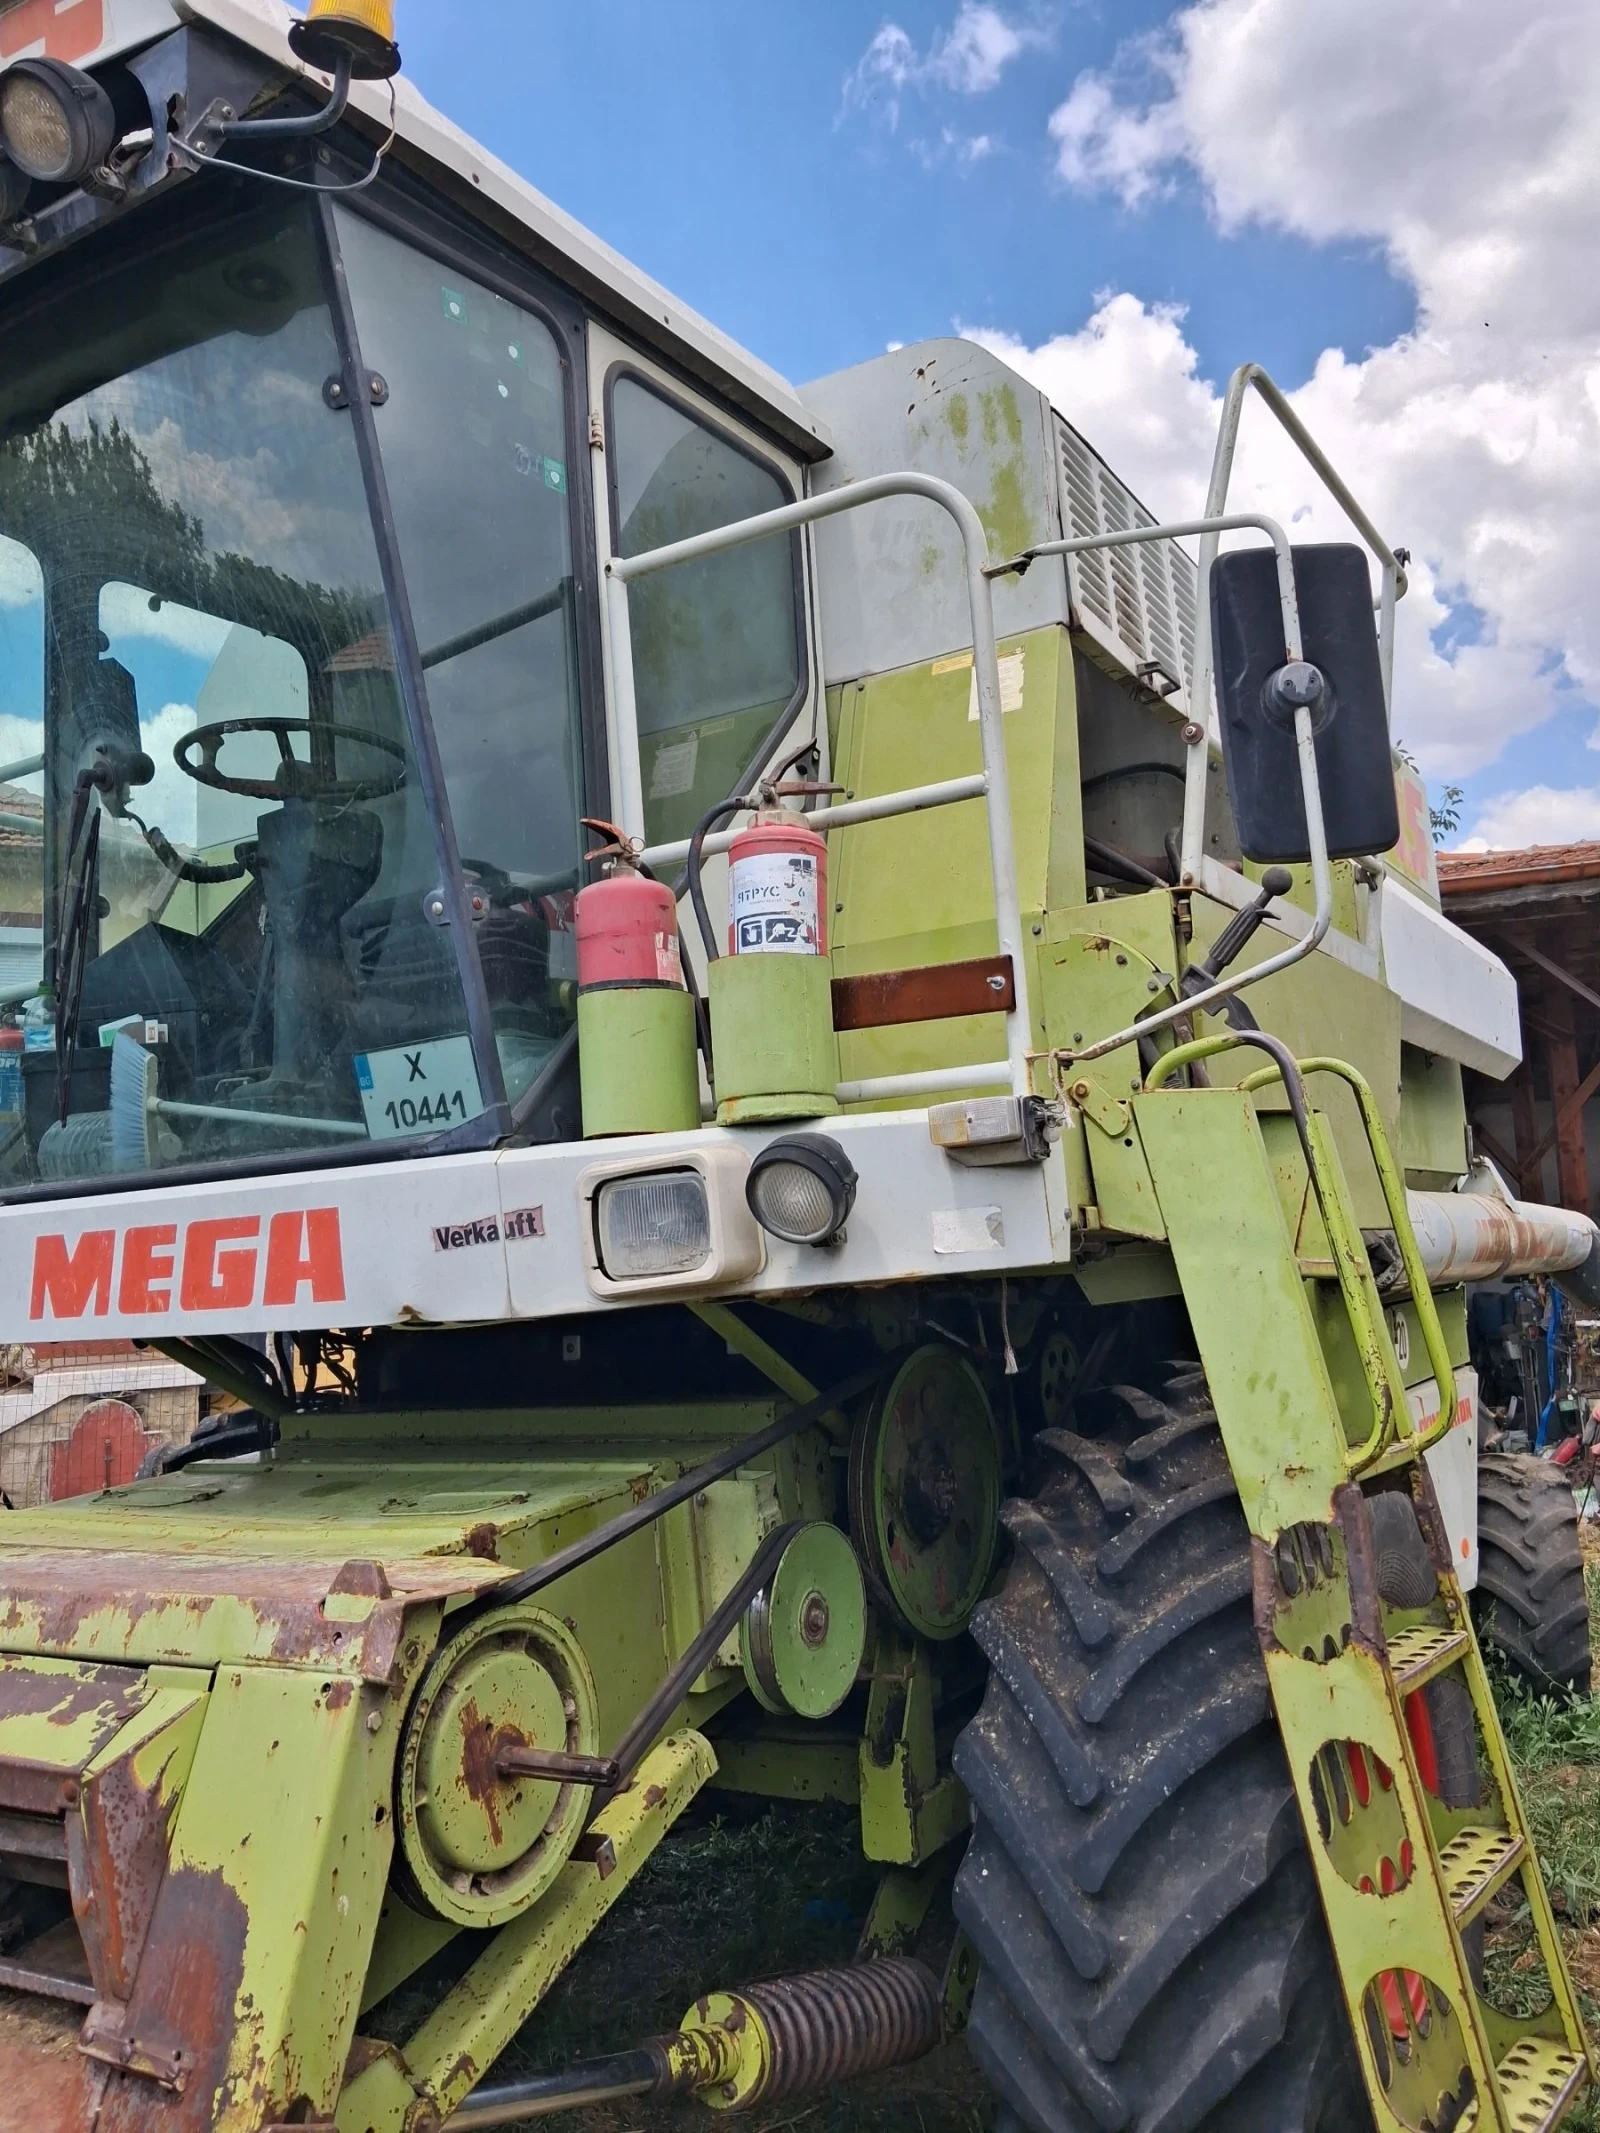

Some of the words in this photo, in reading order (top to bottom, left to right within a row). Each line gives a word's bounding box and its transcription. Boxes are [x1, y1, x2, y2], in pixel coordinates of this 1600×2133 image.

[359, 1075, 371, 1087] BG
[403, 1051, 427, 1082] X
[384, 1090, 467, 1129] 10441
[436, 1212, 537, 1250] Verkauft
[29, 1206, 346, 1320] MEGA
